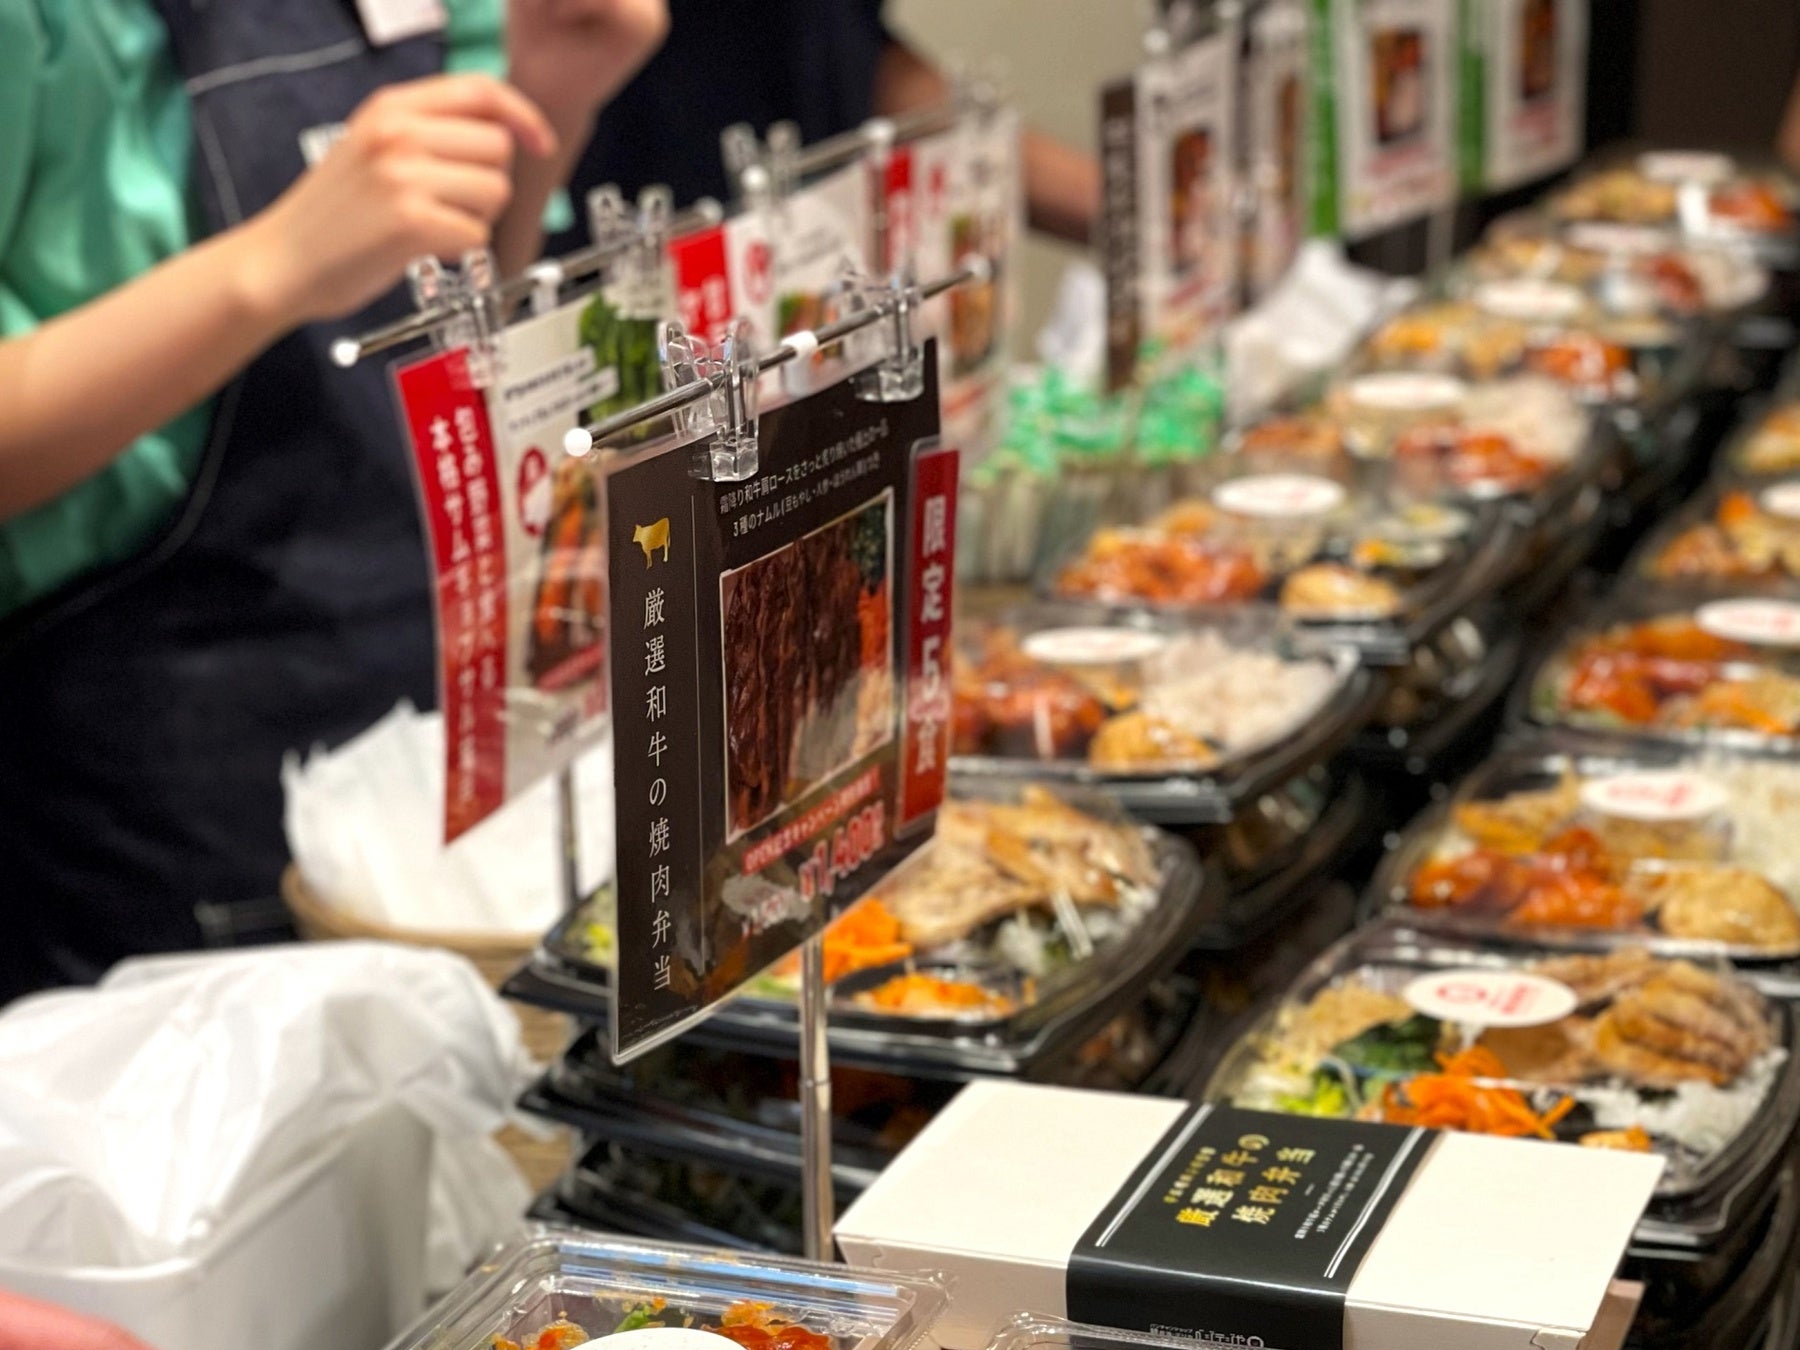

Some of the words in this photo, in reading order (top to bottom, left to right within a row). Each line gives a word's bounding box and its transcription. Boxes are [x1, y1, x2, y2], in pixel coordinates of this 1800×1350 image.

[643, 588, 672, 991] 厳選和牛の焼肉弁当
[1175, 1133, 1270, 1227] 厳選和牛の
[1231, 1146, 1316, 1225] 焼肉弁当
